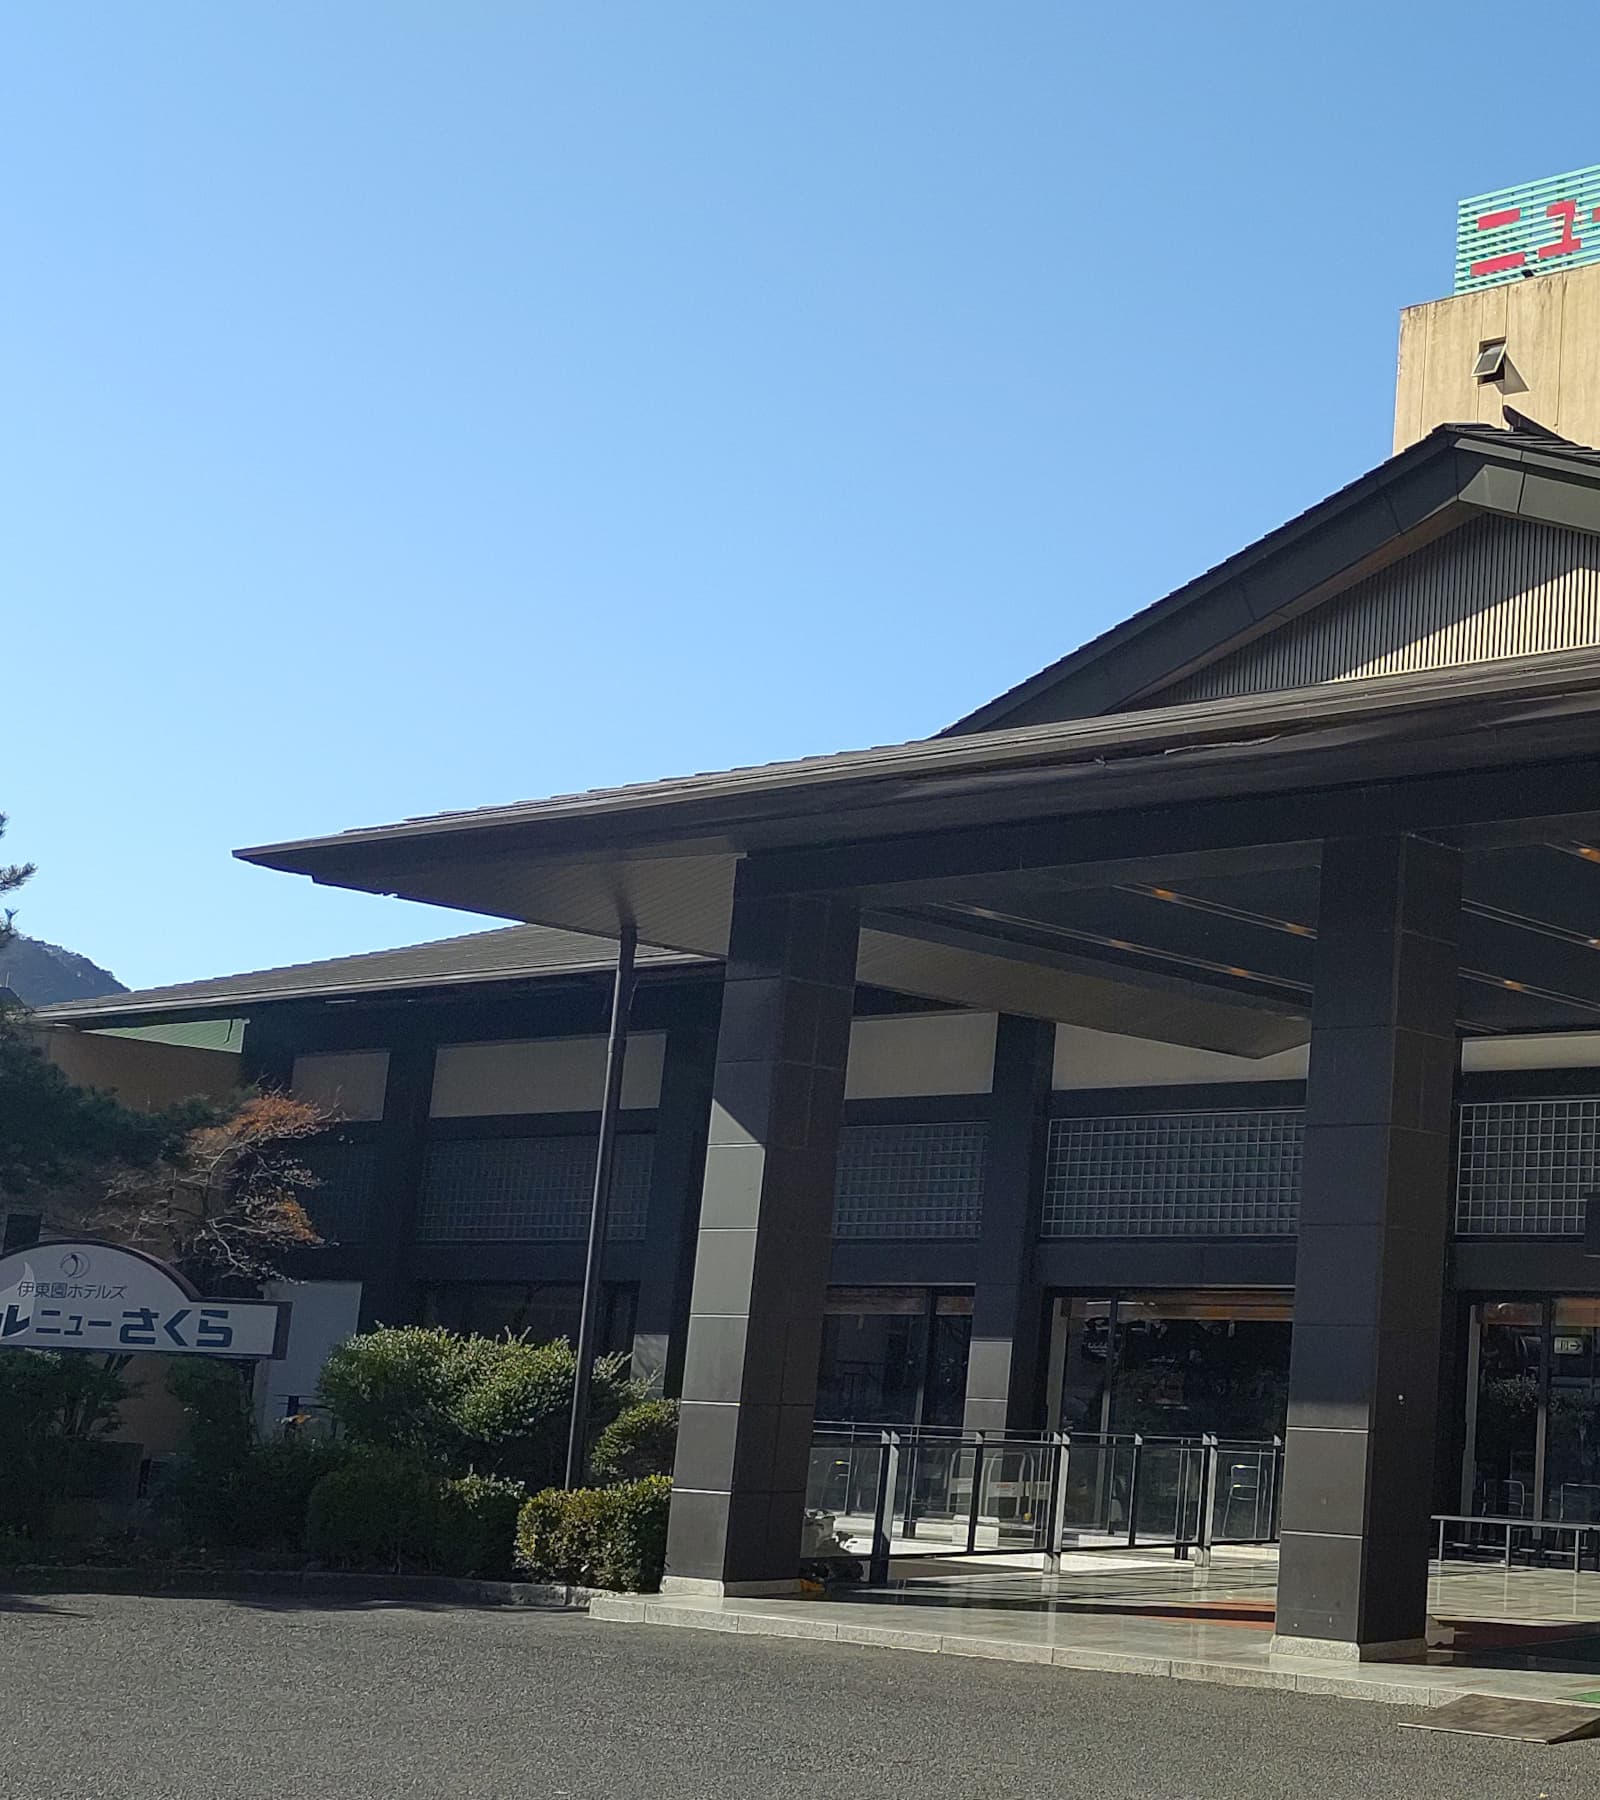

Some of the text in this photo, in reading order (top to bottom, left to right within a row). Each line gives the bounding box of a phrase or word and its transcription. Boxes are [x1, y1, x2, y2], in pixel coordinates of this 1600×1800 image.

[17, 1281, 127, 1299] 伊東園ホテルズ
